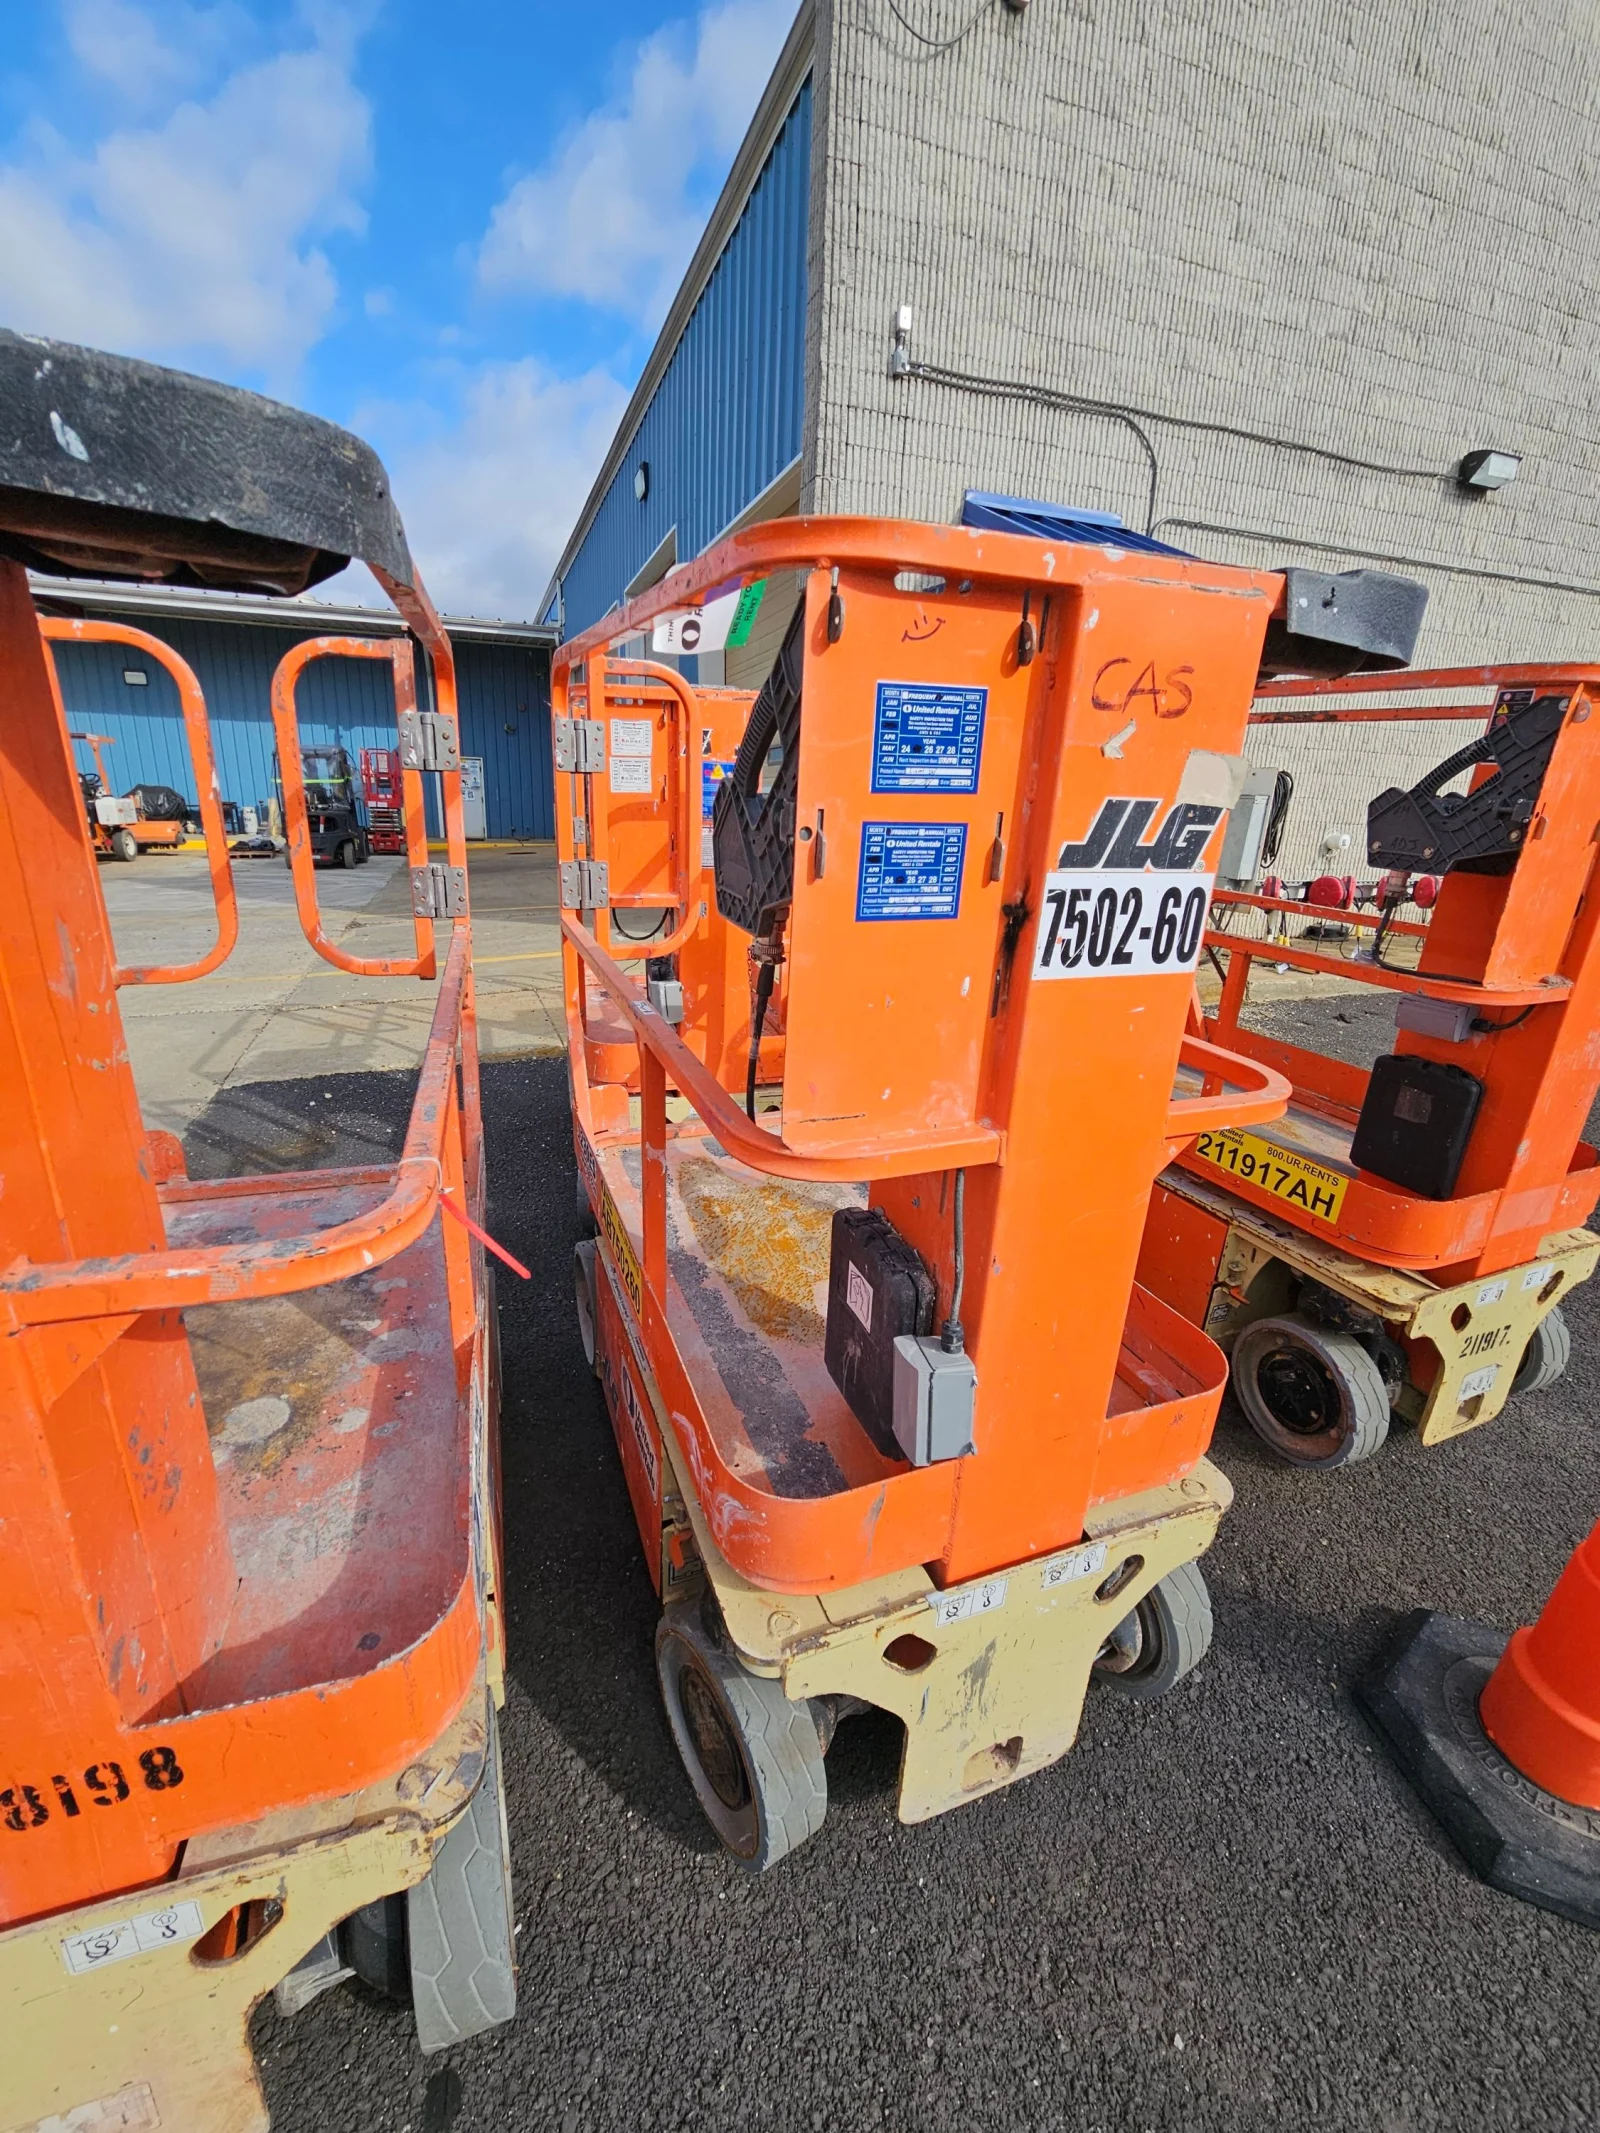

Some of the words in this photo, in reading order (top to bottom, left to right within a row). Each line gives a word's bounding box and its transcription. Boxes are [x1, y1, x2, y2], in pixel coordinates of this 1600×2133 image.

[730, 603, 745, 635] READY
[744, 597, 758, 622] RENT
[1091, 657, 1195, 719] CAS
[912, 705, 935, 714] United
[935, 706, 960, 715] Rentals
[883, 733, 896, 741] APR
[901, 745, 911, 753] 24
[924, 746, 933, 754] 26
[935, 746, 945, 754] 27
[946, 746, 956, 755] 28
[895, 840, 918, 848] United
[918, 840, 941, 848] Rentals
[1058, 799, 1228, 870] JLG
[885, 876, 894, 884] 24
[907, 876, 916, 884] 26
[917, 876, 927, 884] 27
[928, 876, 937, 884] 28
[1040, 886, 1207, 970] 7502-60
[1218, 1131, 1244, 1147] Rentals
[1196, 1133, 1336, 1218] 211917AH
[1266, 1147, 1340, 1187] 800.UR.RENTS
